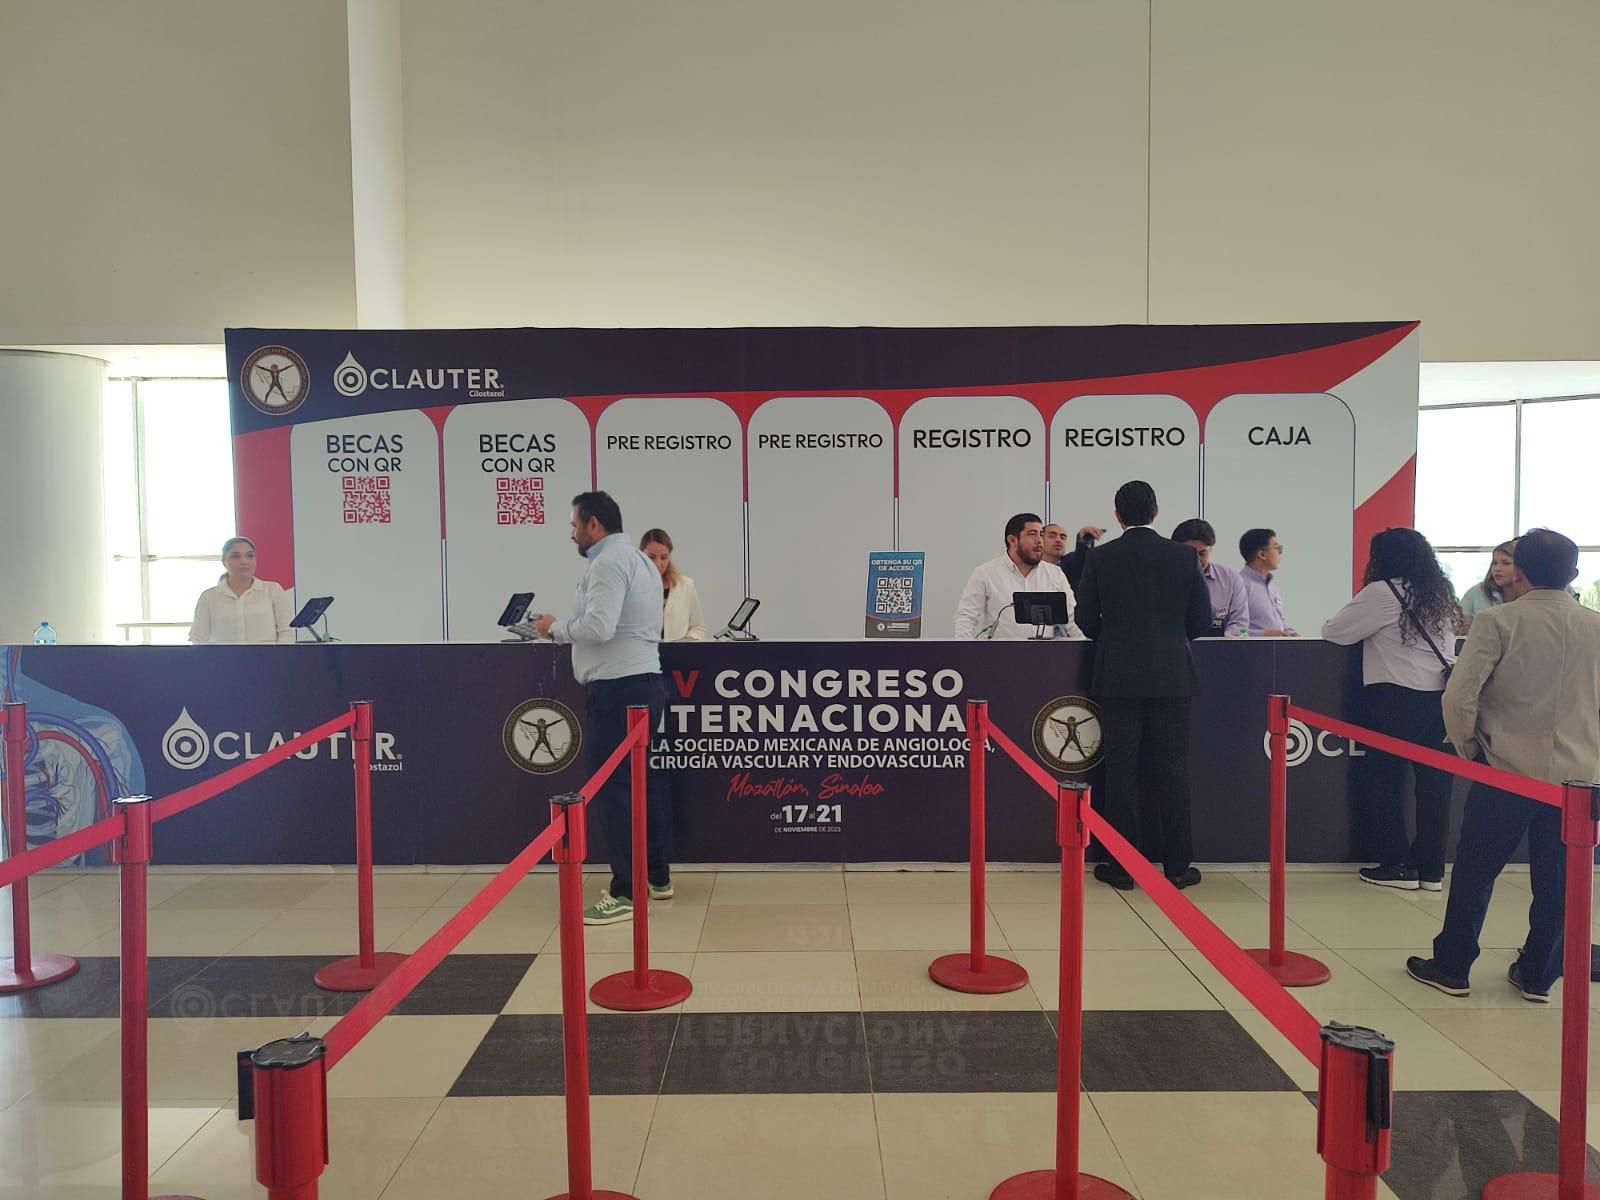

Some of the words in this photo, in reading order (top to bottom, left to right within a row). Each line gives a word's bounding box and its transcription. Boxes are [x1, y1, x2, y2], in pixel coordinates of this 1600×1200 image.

[369, 368, 500, 390] CLAUTER
[326, 434, 403, 453] BECAS
[479, 433, 556, 453] BECAS
[607, 435, 639, 450] PRE
[644, 435, 732, 450] REGISTRO
[758, 434, 791, 449] PRE
[796, 433, 883, 448] REGISTRO
[913, 429, 1032, 448] REGISTRO
[1065, 427, 1185, 447] REGISTRO
[1248, 426, 1311, 446] CAJA
[328, 457, 369, 473] CON
[374, 457, 402, 473] QR
[481, 457, 523, 473] CON
[528, 457, 556, 473] QR
[664, 670, 699, 698] V
[714, 669, 963, 698] CONGRESO
[657, 704, 967, 733] TERNACIONA
[213, 731, 396, 760] CLAUTR
[650, 738, 670, 752] LA
[674, 738, 760, 752] SOCIEDAD
[764, 738, 853, 752] MEXICANA
[857, 738, 880, 751] DE
[883, 738, 995, 753] ANGIOLOGA,
[649, 753, 718, 769] CIRUGÍA
[721, 755, 810, 768] VASCULAR
[812, 755, 823, 768] Y
[827, 755, 965, 768] ENDOVASCULAR
[818, 773, 885, 799] Sinaloa
[770, 811, 782, 820] del
[782, 805, 809, 823] 17
[809, 811, 816, 819] al
[816, 804, 842, 823] 21
